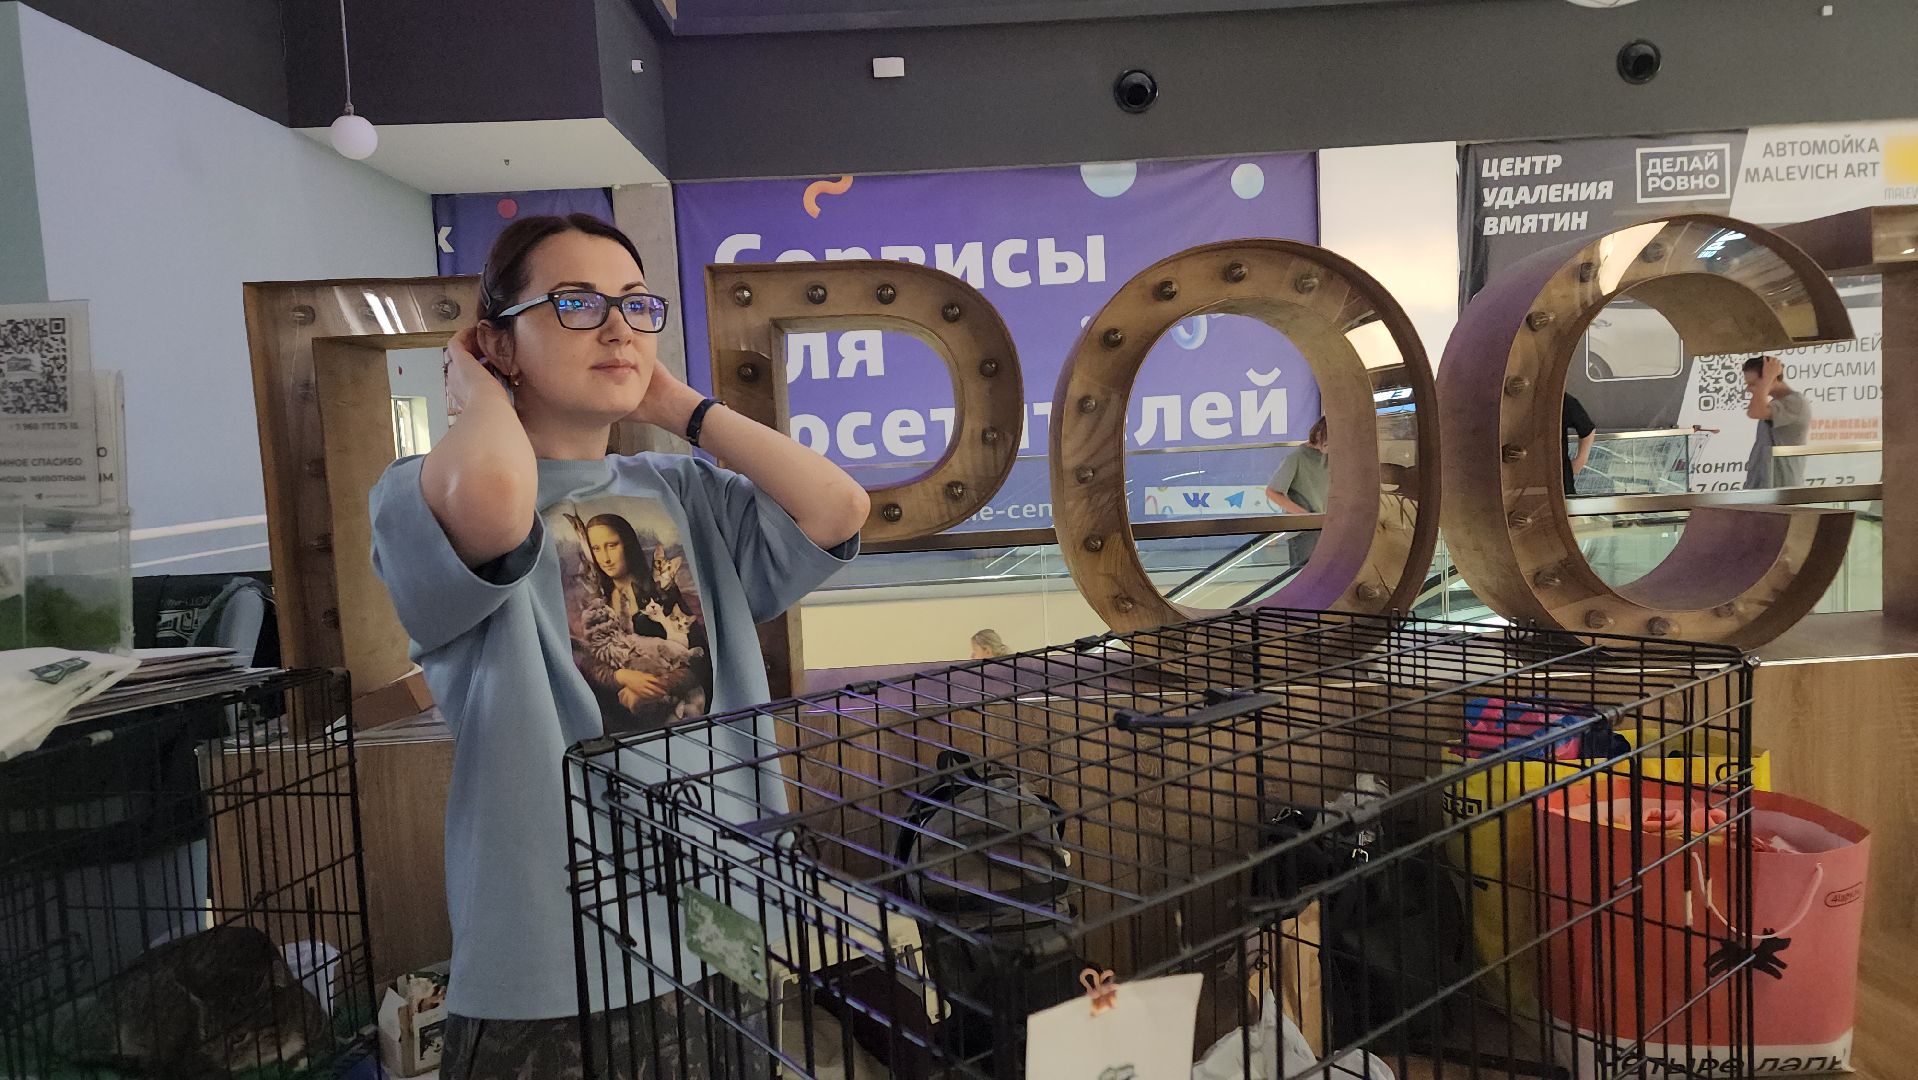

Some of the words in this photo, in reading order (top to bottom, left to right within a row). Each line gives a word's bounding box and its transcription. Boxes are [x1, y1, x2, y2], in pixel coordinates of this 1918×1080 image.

[1762, 135, 1880, 158] АВТОМОЙКА
[1481, 154, 1562, 180] ЦЕНТР
[1646, 152, 1718, 176] ДЕЛАЙ
[1744, 164, 1838, 183] MALEVICH
[1844, 161, 1880, 178] ART
[1647, 173, 1720, 192] РОВНО
[1482, 180, 1613, 210] УДАЛЕНИЯ
[1482, 211, 1588, 236] ВМЯТИН
[1784, 361, 1877, 380] ОНУСАМИ
[31, 457, 83, 467] СПАСИБО
